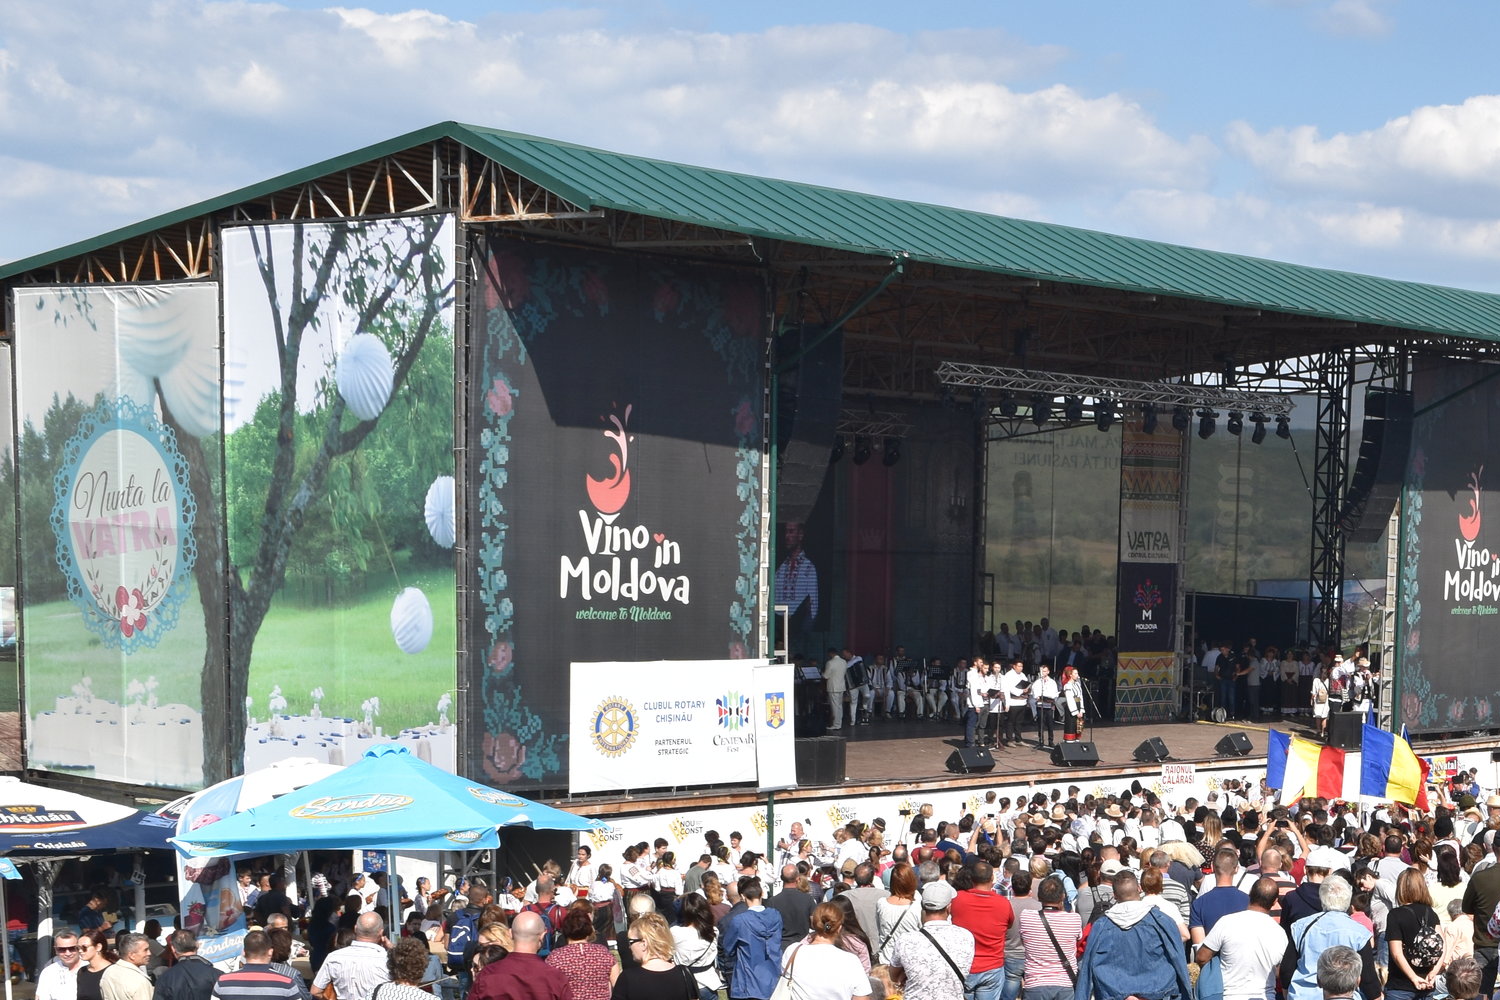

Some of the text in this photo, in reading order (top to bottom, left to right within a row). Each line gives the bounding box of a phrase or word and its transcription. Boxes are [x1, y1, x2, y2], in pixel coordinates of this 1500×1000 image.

[74, 468, 170, 518] Nunta la
[71, 507, 176, 560] VATRA
[579, 509, 680, 568] Vino in
[1127, 531, 1171, 551] VATRA
[1455, 538, 1490, 570] Vino
[560, 555, 690, 605] Moldova
[575, 606, 672, 622] welcome to Moldova
[1142, 610, 1152, 621] M
[643, 700, 705, 710] CLUBUL ROTARY
[655, 738, 692, 746] PARTENERUL
[1165, 766, 1193, 774] RAIONUL
[296, 794, 408, 817] Sandra
[836, 813, 857, 822] CONST
[598, 834, 623, 842] CONST
[680, 827, 703, 835] CONST
